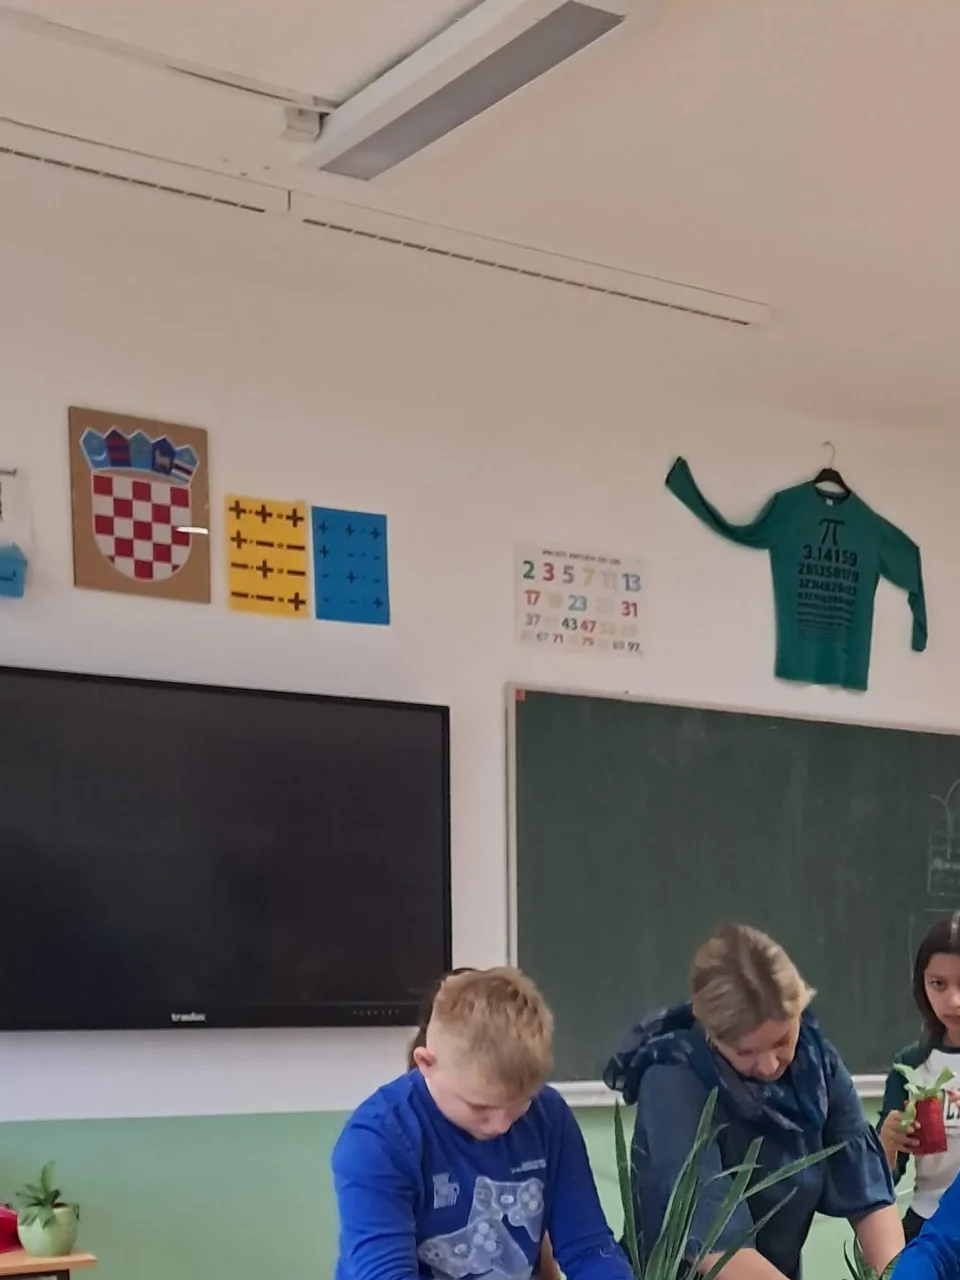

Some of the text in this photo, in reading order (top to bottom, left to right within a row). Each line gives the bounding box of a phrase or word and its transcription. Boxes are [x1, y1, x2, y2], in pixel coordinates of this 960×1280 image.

[802, 544, 858, 567] 3.14159
[523, 560, 535, 580] 2
[542, 562, 555, 582] 3
[562, 564, 575, 584] 5
[582, 565, 595, 588] 7
[622, 572, 641, 592] 13
[525, 589, 541, 606] 17
[568, 594, 588, 611] 23
[621, 600, 638, 618] 31
[525, 613, 541, 626] 37
[561, 618, 578, 631] 43
[580, 620, 596, 633] 47
